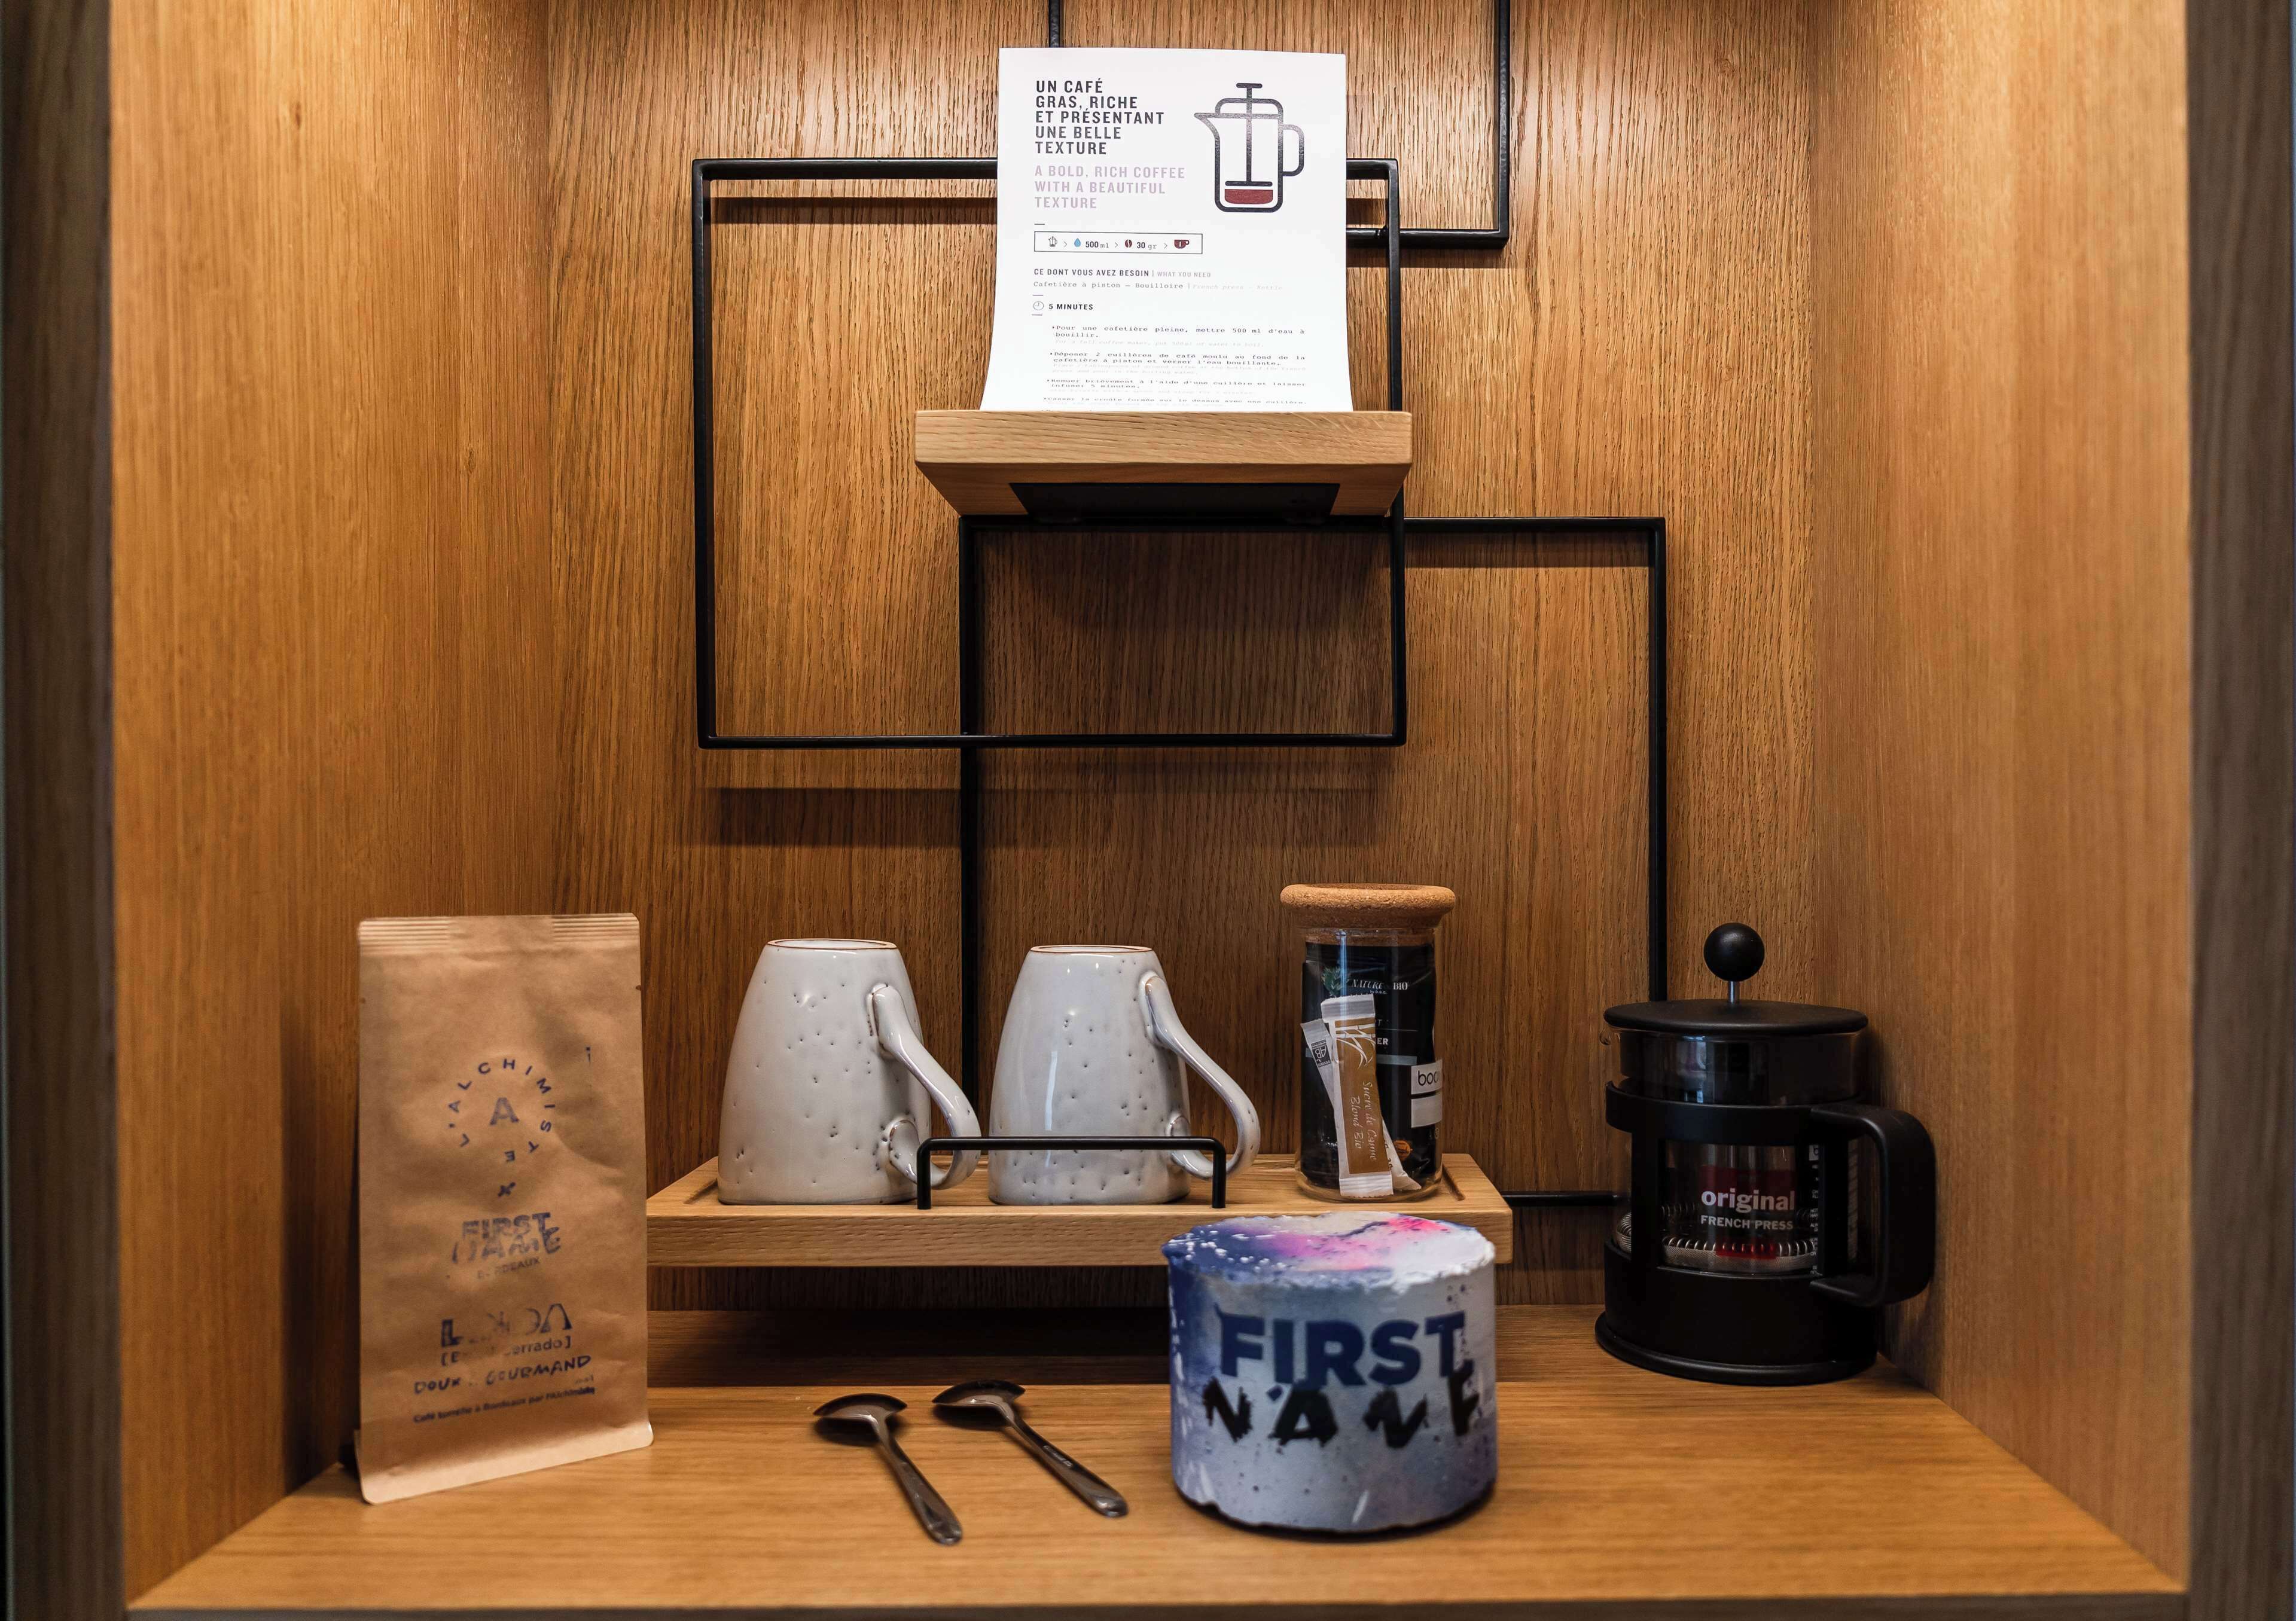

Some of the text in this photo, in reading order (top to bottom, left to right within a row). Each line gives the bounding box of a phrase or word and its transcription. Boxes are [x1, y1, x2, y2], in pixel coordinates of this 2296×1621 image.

[1035, 78, 1104, 94] UN CAFÉ
[1035, 96, 1139, 110] GRAS, RICHE
[1035, 108, 1165, 125] ET PRÉSENTANT
[1035, 126, 1122, 140] UNE BELLE
[1034, 141, 1108, 155] TEXTURE
[1033, 164, 1186, 179] A BOLD, RICH COFFEE
[1033, 180, 1166, 195] WITH A BEAUTIFUL
[1033, 196, 1098, 209] TEXTURE
[1392, 981, 1408, 991] BIO
[489, 1097, 520, 1127] A
[1700, 1187, 1795, 1214] original
[462, 1211, 552, 1241] FIRST
[1700, 1214, 1794, 1231] FRENCH PRESS
[1216, 1307, 1466, 1387] FIRST
[485, 1354, 592, 1386] GOURMAND
[413, 1377, 461, 1395] DOUX
